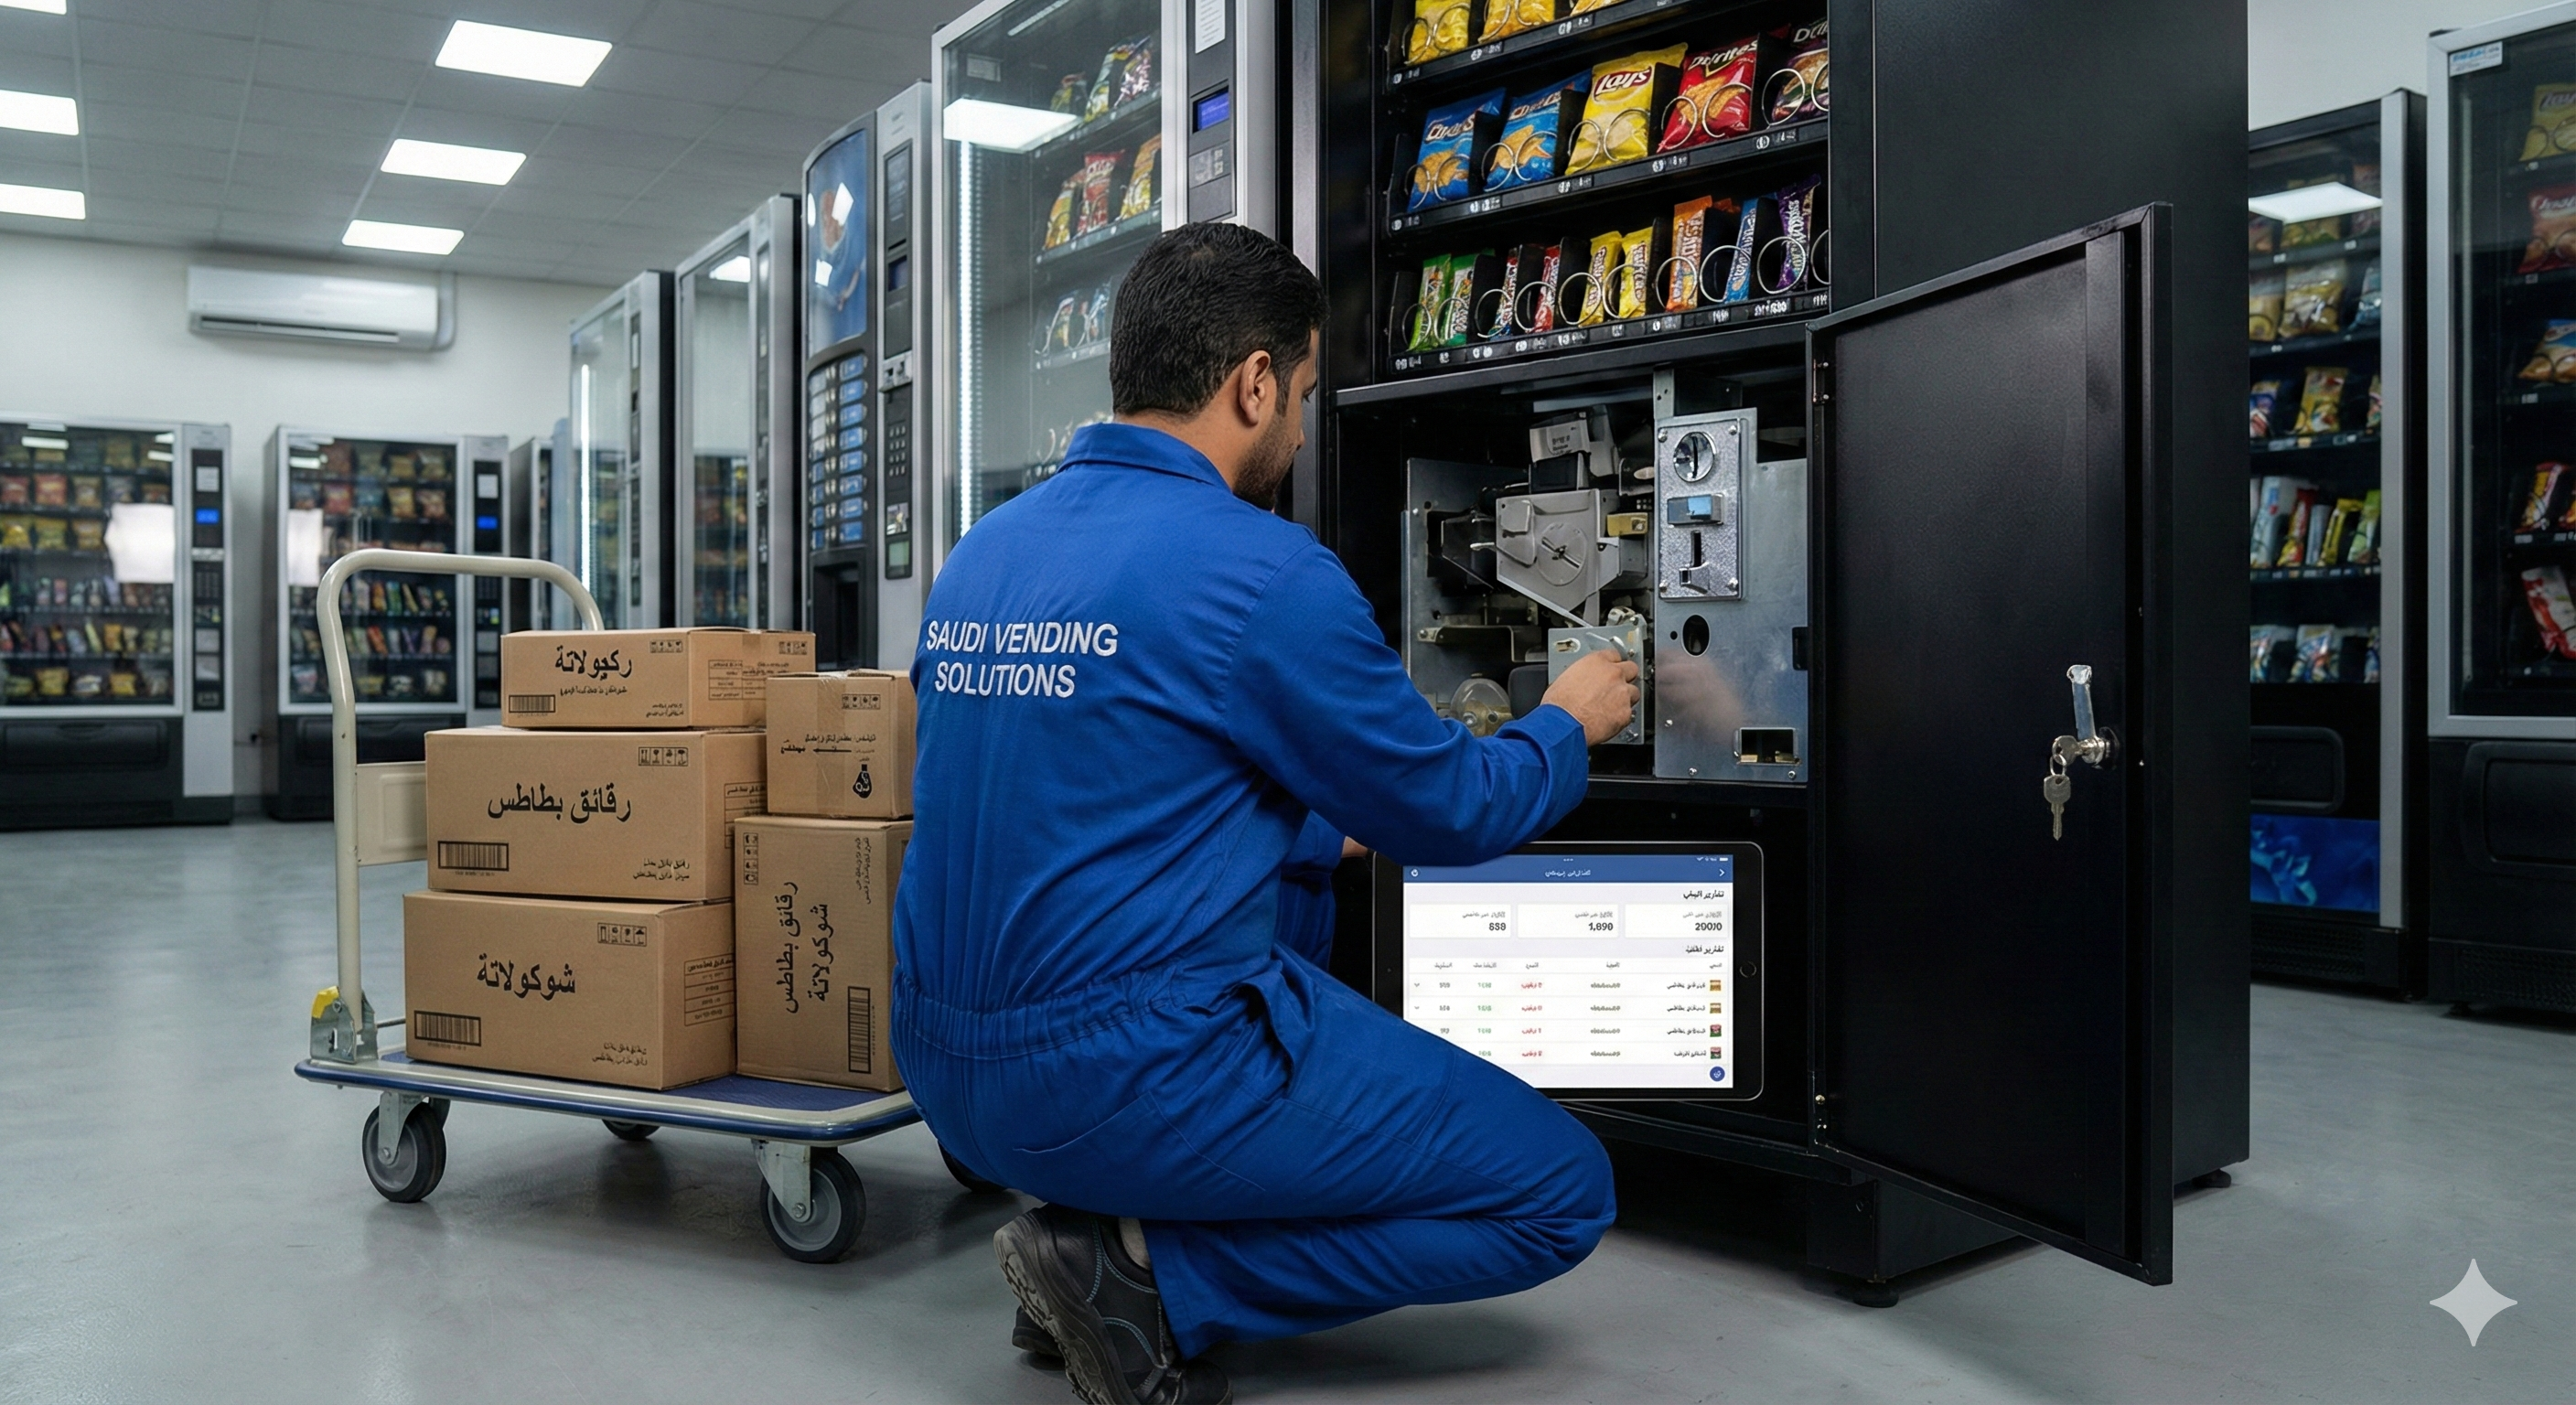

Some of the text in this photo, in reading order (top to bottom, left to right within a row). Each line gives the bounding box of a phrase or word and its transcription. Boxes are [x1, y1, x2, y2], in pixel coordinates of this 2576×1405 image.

[927, 620, 1118, 657] SAUDI VENDING
[935, 661, 1076, 698] SOLUTIONS
[488, 782, 631, 824] رقائق بطاطس
[808, 904, 834, 1002] شوكولاتة
[477, 952, 575, 1002] شوكولاتة
[776, 942, 799, 1014] بطاطس
